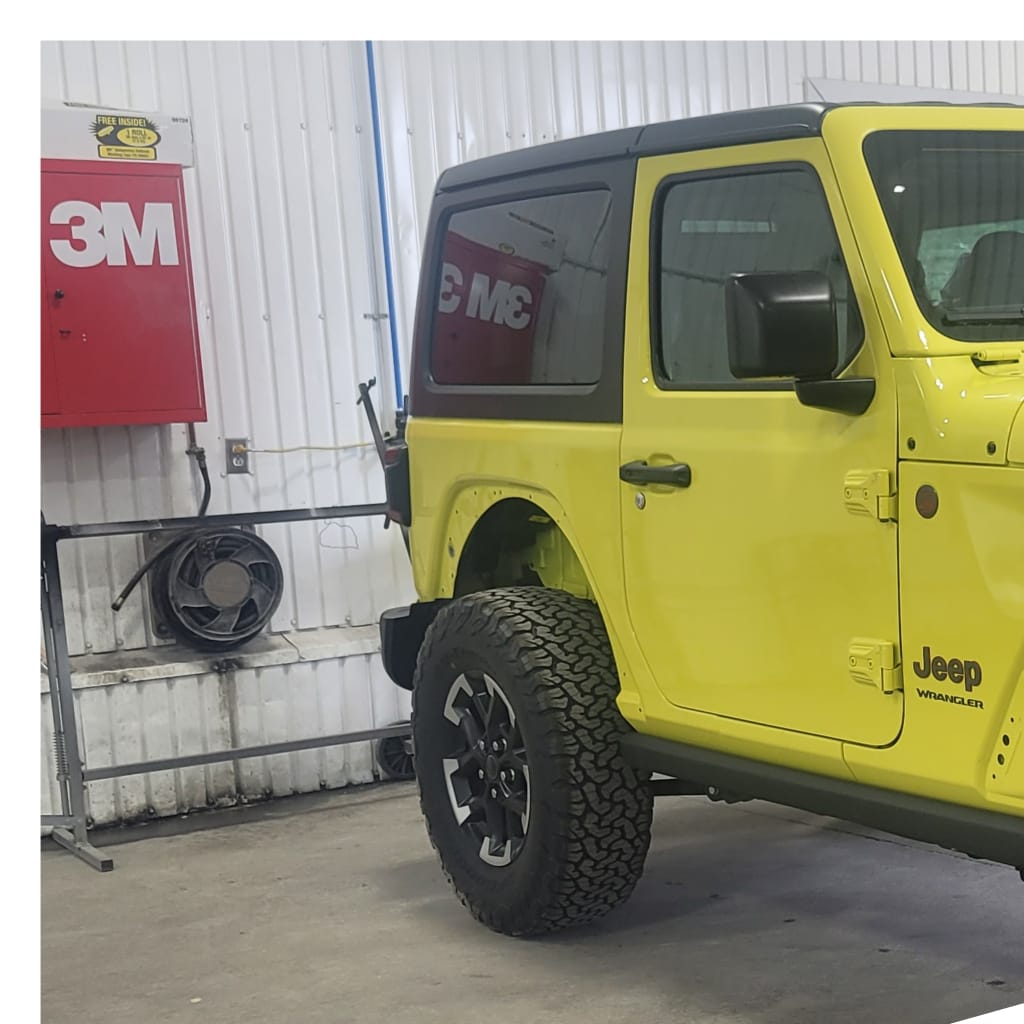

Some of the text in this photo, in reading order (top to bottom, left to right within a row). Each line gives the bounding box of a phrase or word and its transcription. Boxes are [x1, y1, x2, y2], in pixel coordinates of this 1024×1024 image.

[97, 116, 117, 125] FREE
[49, 200, 180, 268] 3M
[912, 646, 982, 692] Jeep
[916, 687, 984, 710] WRANGLER
